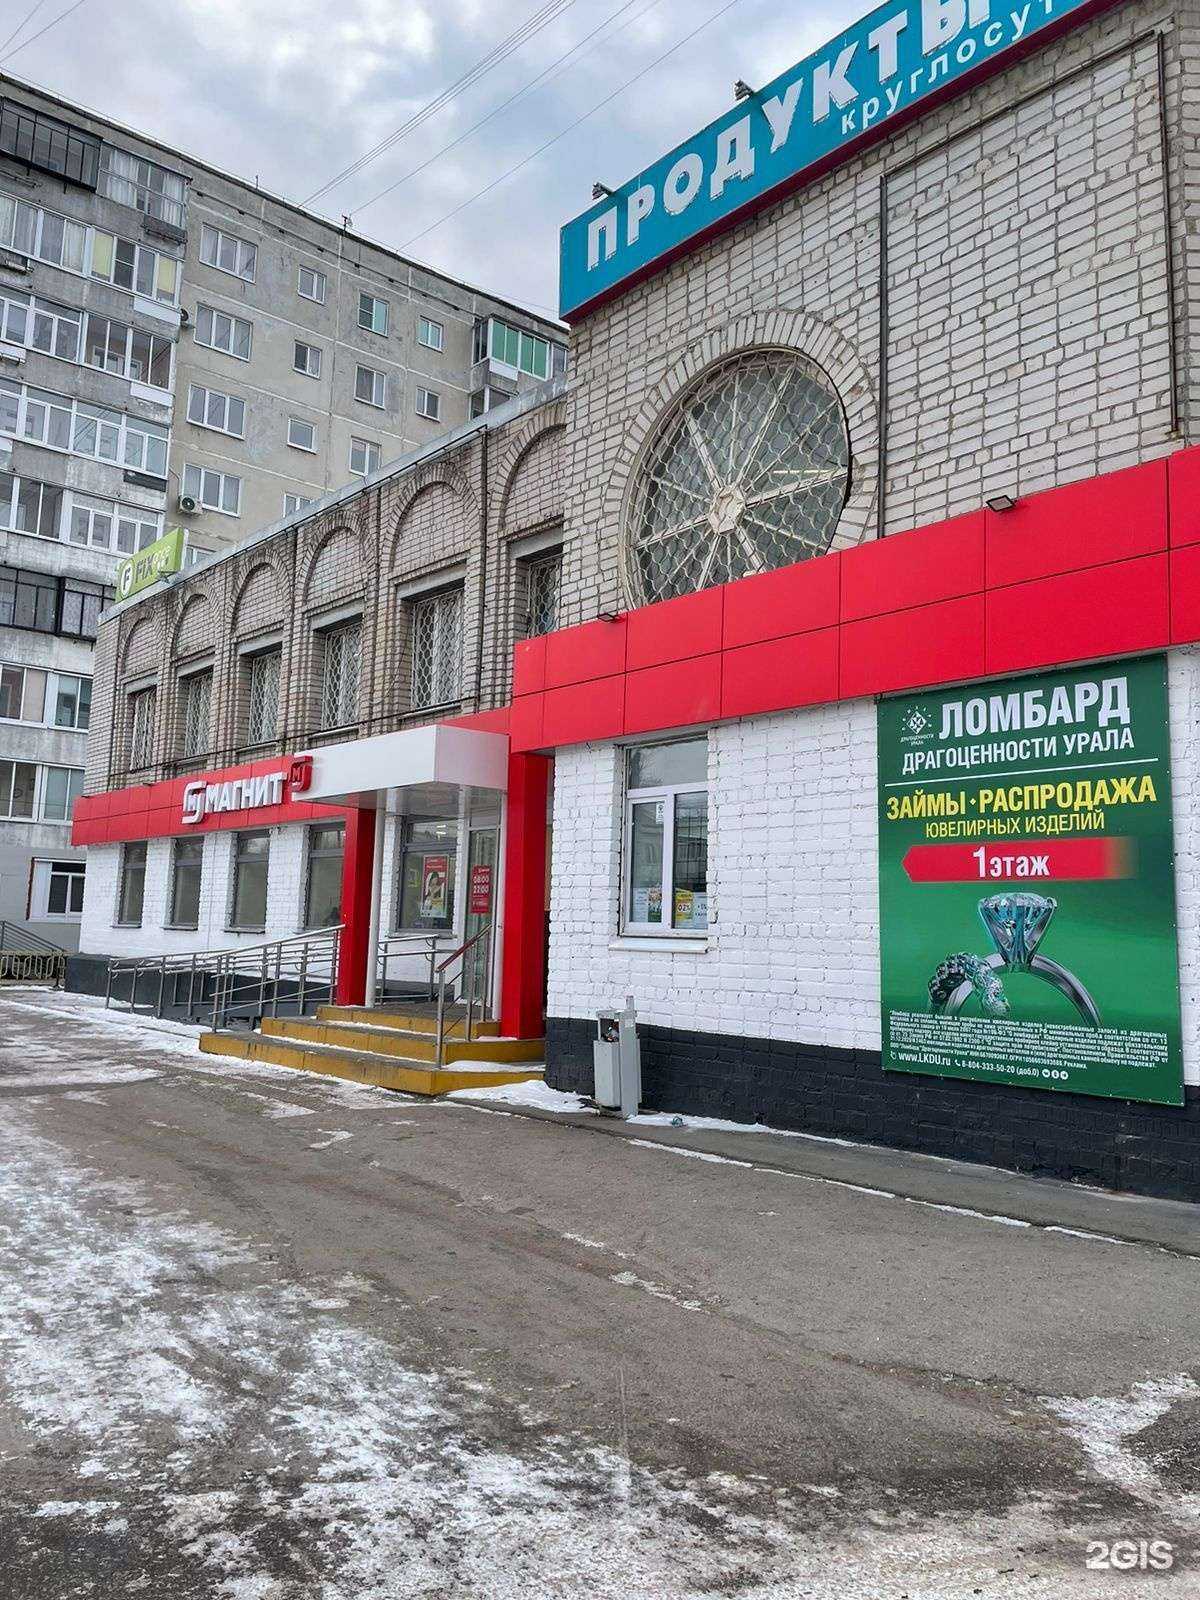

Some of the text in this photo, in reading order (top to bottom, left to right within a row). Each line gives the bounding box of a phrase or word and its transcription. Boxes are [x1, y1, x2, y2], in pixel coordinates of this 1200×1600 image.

[587, 0, 990, 272] ПРОДУКТЫ
[939, 677, 1131, 739] ЛОМБАРД
[902, 727, 1134, 775] ДРАГОЦЕННОСТИ УРАЛА
[205, 772, 287, 813] МАГНИТ
[887, 775, 1157, 819] ЗАЙМЫ РАСПРОДАЖА
[926, 810, 1104, 838] ЮВЕЛИРНЫХ ИЗДЕЛИЙ
